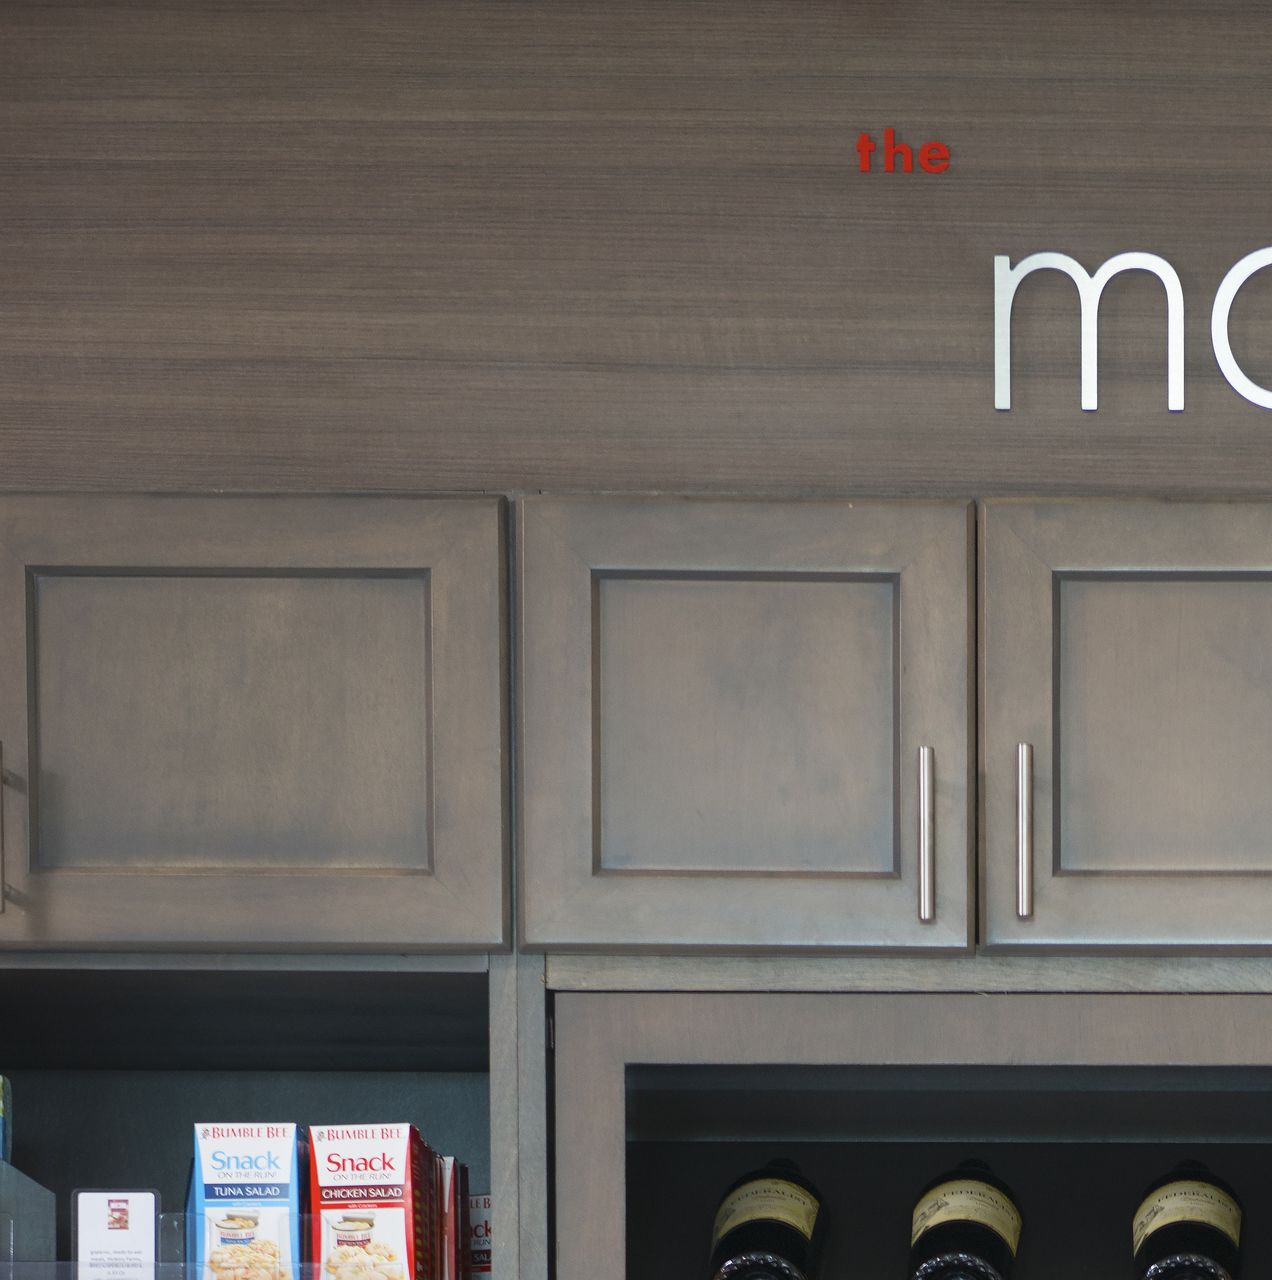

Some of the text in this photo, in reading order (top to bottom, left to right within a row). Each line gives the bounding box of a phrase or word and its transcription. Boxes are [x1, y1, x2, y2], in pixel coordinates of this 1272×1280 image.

[855, 126, 951, 174] the
[211, 1150, 281, 1171] Snack
[327, 1152, 396, 1173] Snack
[214, 1186, 281, 1197] TUNA SALAD
[322, 1187, 402, 1199] CHICKEN SALAD
